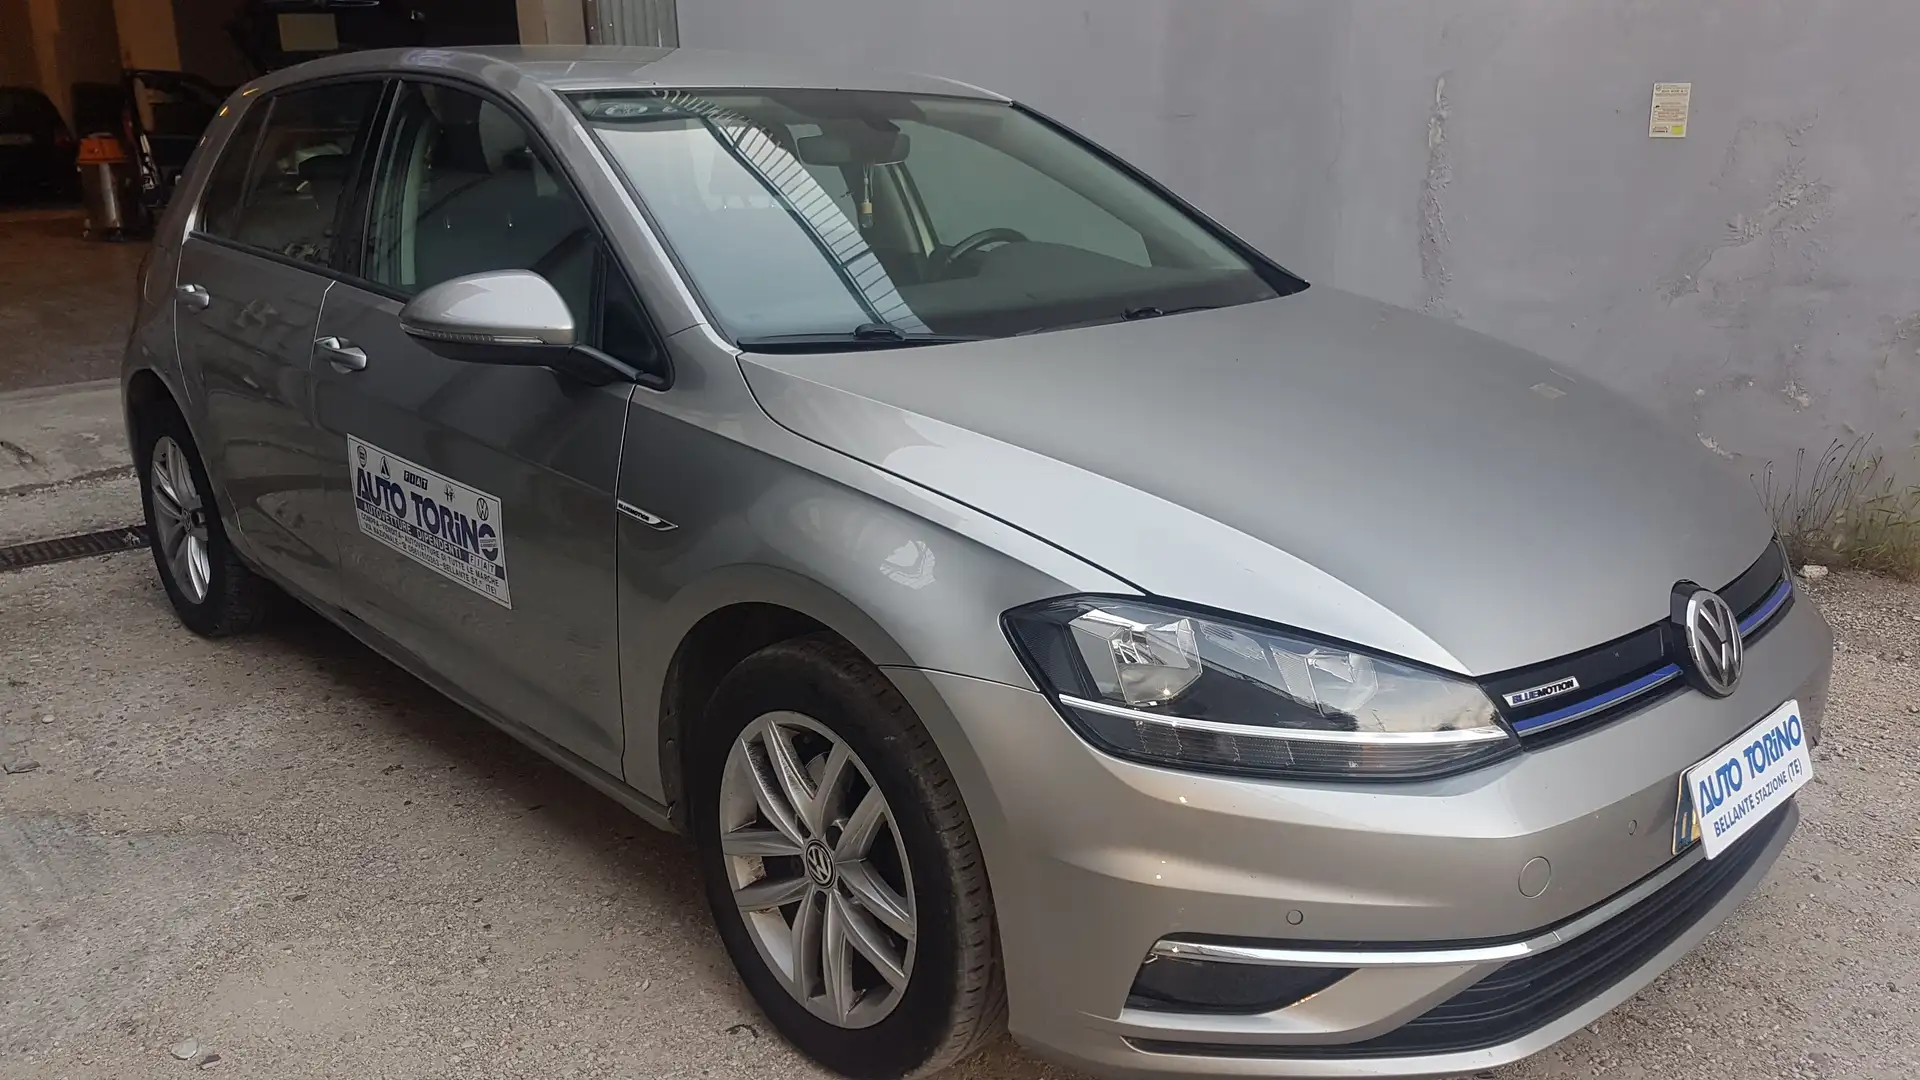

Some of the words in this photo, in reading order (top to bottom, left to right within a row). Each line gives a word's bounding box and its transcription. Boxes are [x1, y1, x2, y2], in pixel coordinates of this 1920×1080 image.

[357, 467, 407, 519] AUTO
[404, 470, 428, 490] FIAT
[363, 503, 412, 534] AUTOVETTURE
[416, 529, 462, 559] DIPENDENTI
[469, 553, 496, 576] FIAT
[1511, 680, 1575, 704] BLUEMOTION
[1699, 758, 1743, 819] AUTO
[1713, 794, 1755, 838] BELLANTE
[1755, 772, 1788, 805] STAZIONE
[1788, 758, 1803, 783] (TE)
